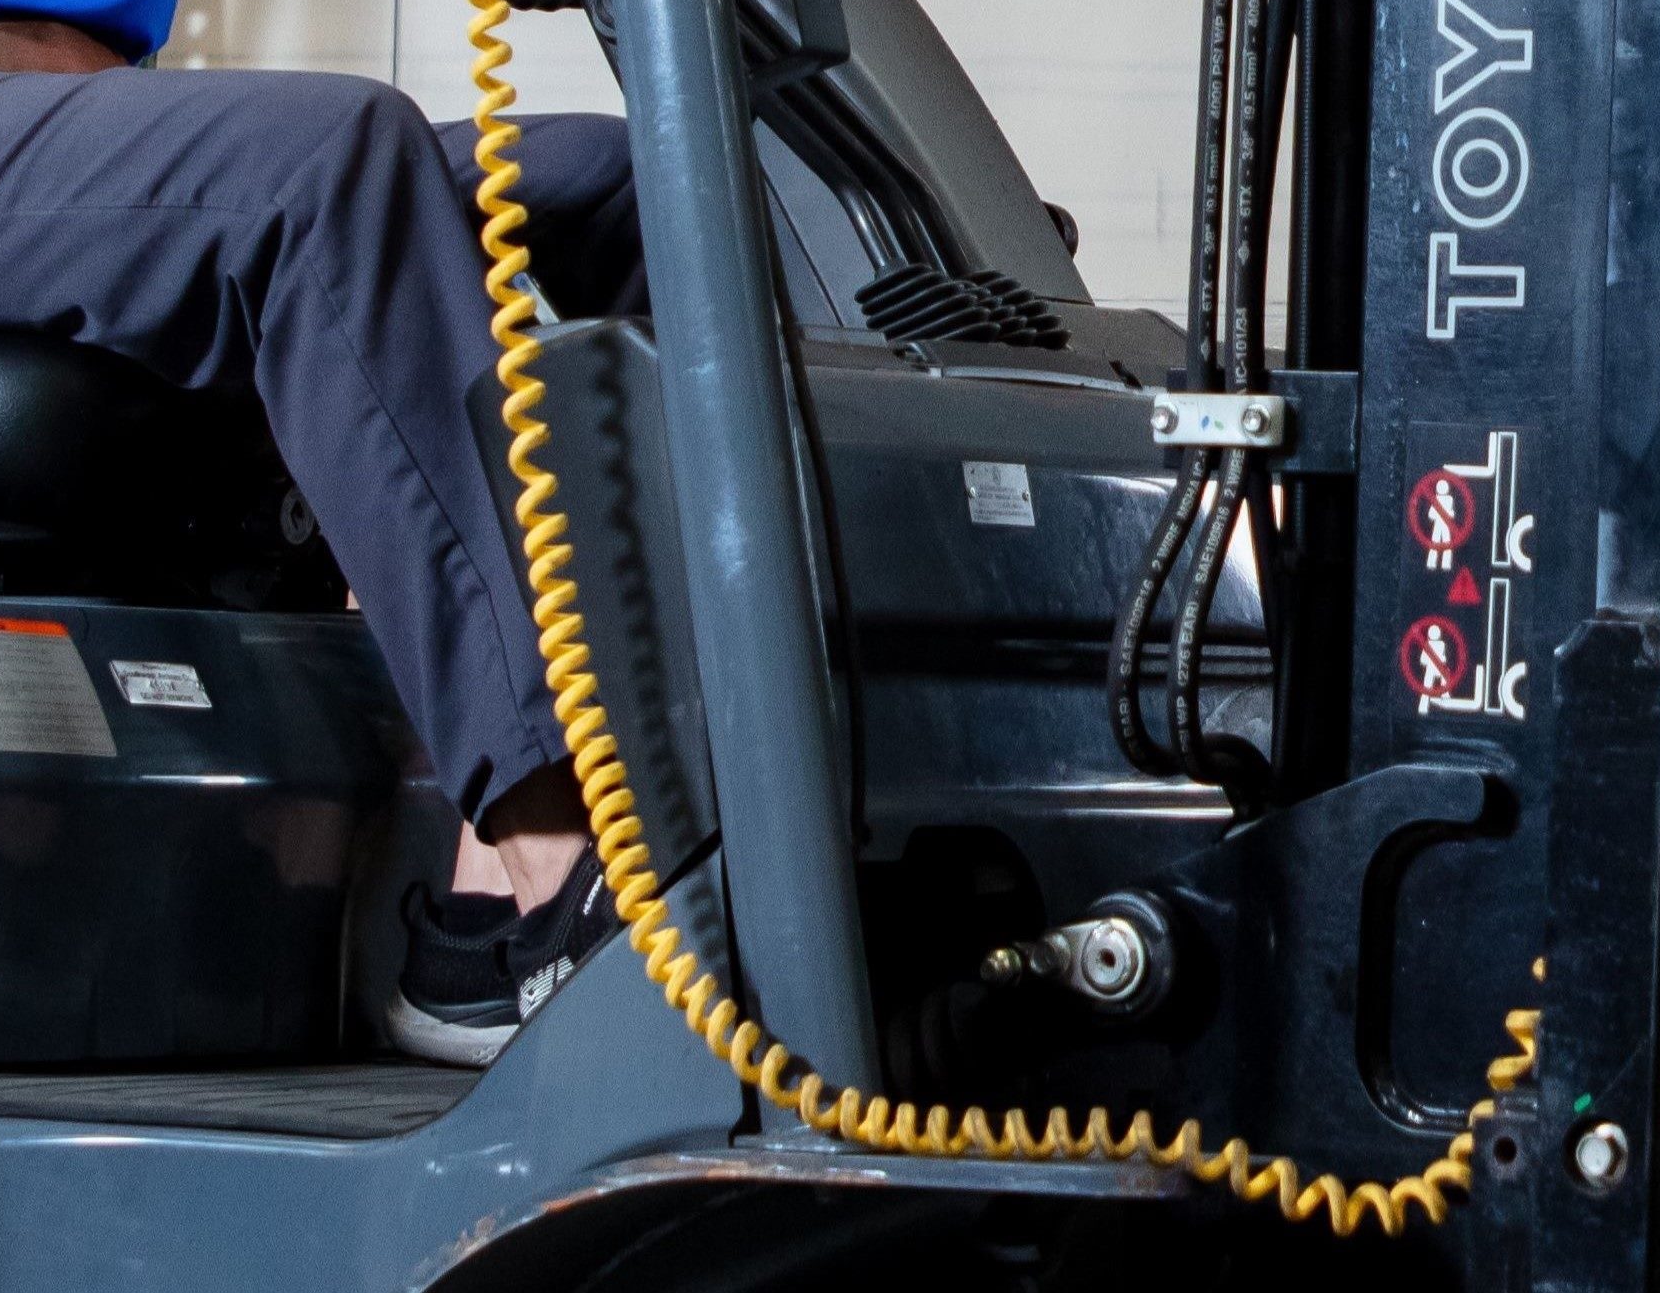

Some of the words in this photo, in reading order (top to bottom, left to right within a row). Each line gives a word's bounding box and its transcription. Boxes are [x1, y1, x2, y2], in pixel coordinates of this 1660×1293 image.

[1213, 15, 1226, 44] WP
[1212, 48, 1225, 75] PSI
[1210, 81, 1224, 119] 4000
[1225, 449, 1245, 486] WIRE
[1223, 488, 1236, 499] 2
[1156, 521, 1179, 559] WIRE
[1194, 505, 1230, 585] SAE100R16
[1151, 559, 1162, 571] 2
[1180, 601, 1199, 645] BAR)
[1177, 647, 1191, 687] (276
[1176, 695, 1187, 726] WP
